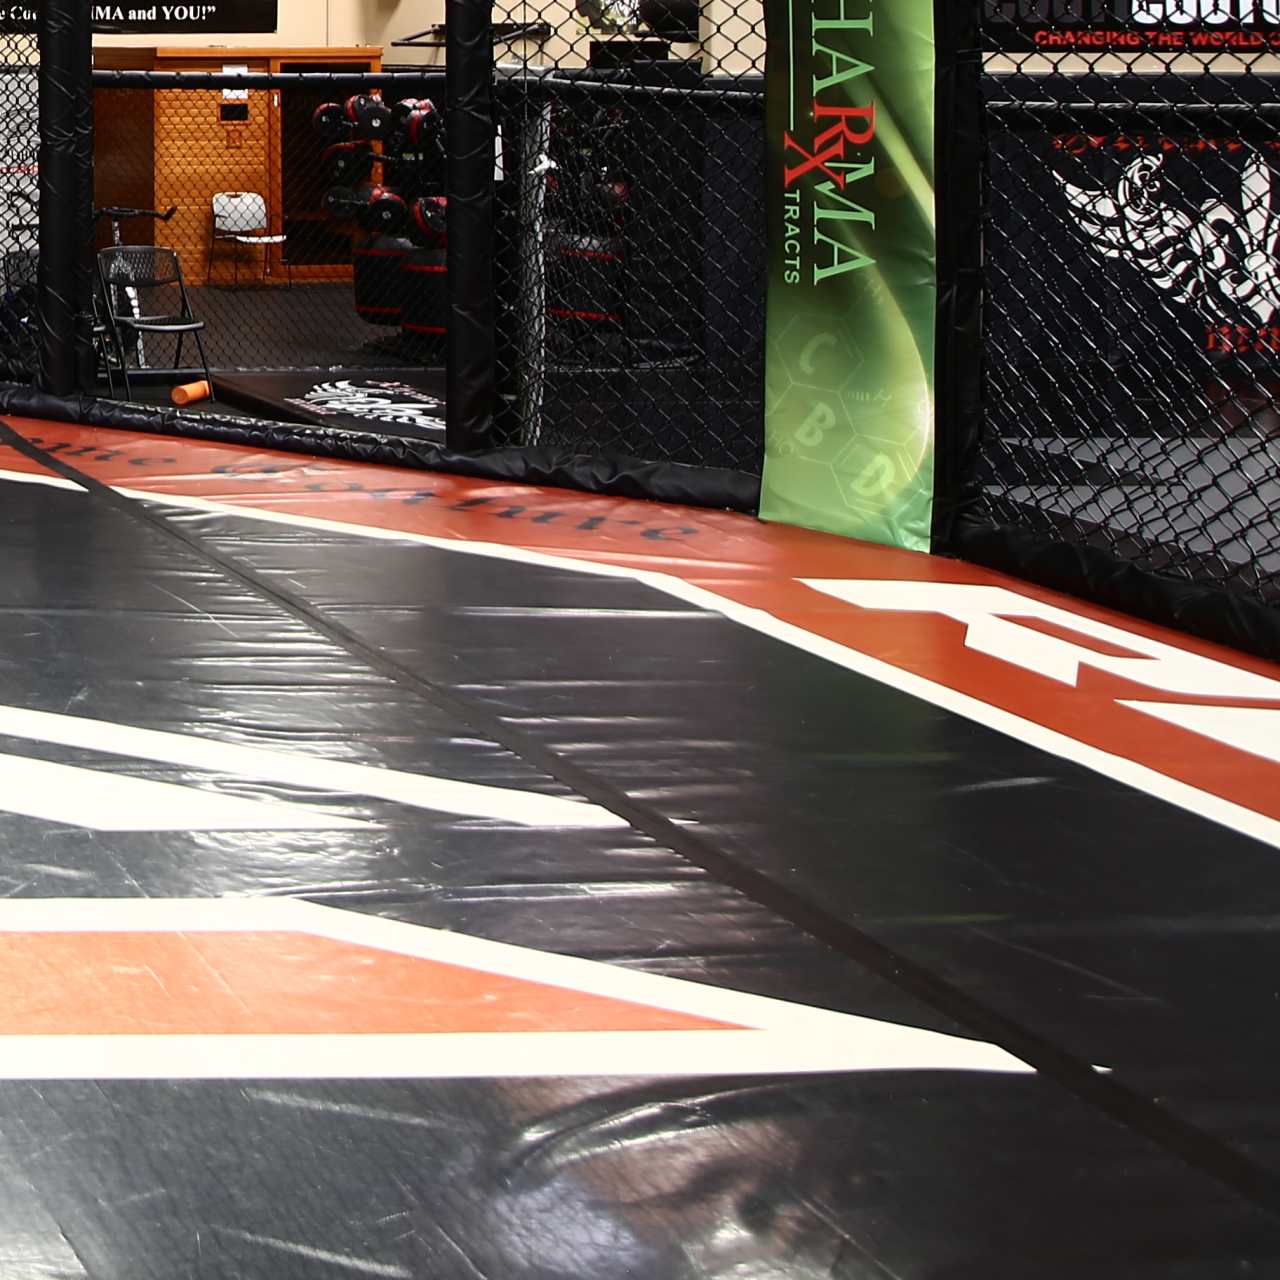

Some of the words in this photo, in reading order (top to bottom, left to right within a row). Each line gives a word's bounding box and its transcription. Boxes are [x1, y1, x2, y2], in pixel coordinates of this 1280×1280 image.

[91, 5, 124, 21] MA
[128, 5, 157, 21] and
[161, 5, 216, 21] YOU!”
[1034, 30, 1142, 46] CHANGING
[1147, 30, 1185, 46] THE
[1190, 30, 1263, 46] WORLD
